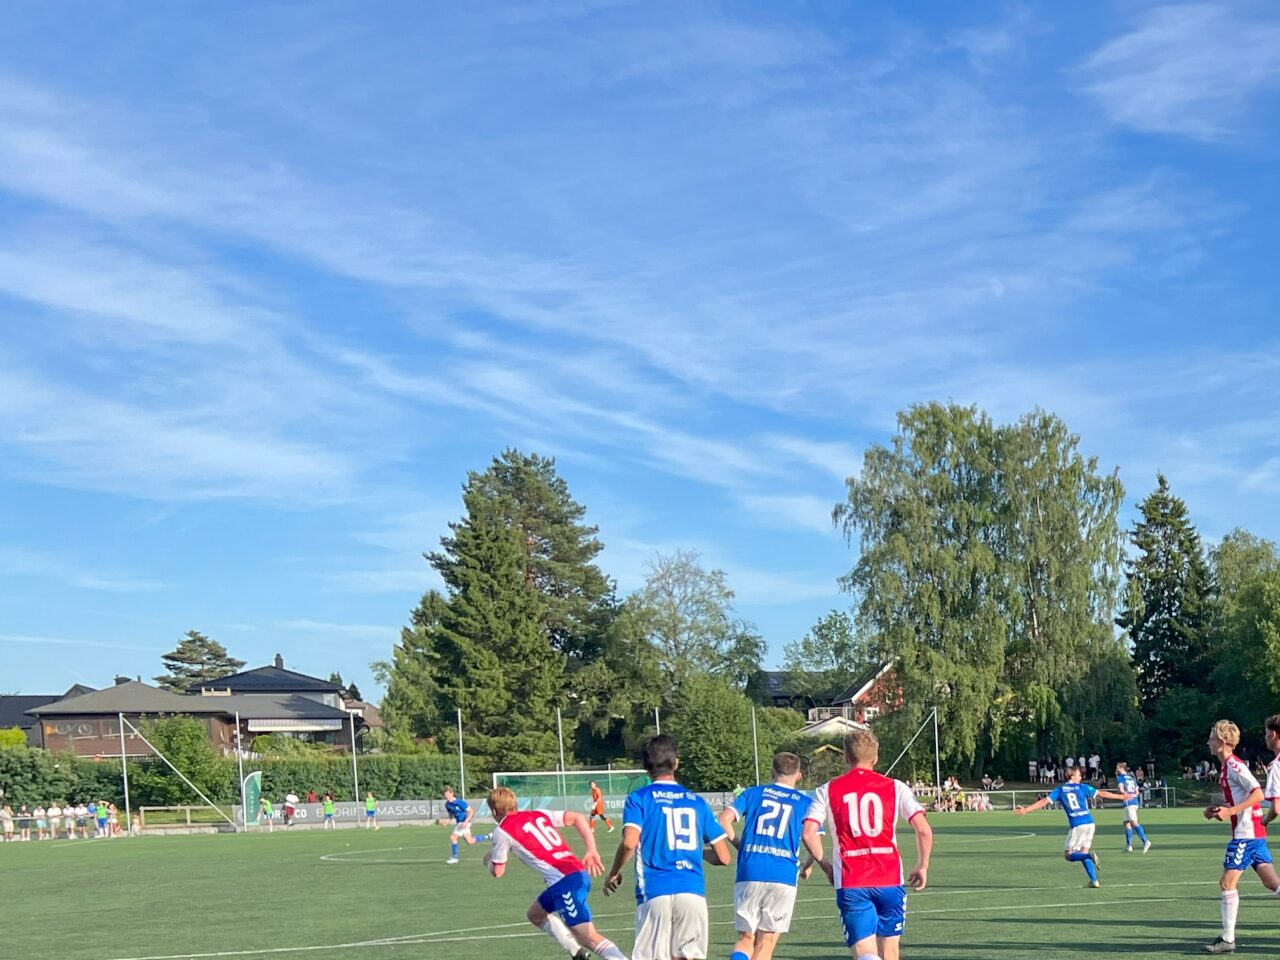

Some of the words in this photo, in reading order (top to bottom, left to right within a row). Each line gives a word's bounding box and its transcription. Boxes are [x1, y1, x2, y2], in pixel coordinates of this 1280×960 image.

[756, 799, 792, 839] 21
[843, 791, 884, 838] 10
[1067, 793, 1080, 810] 8
[522, 816, 562, 851] 16
[661, 806, 697, 851] 19
